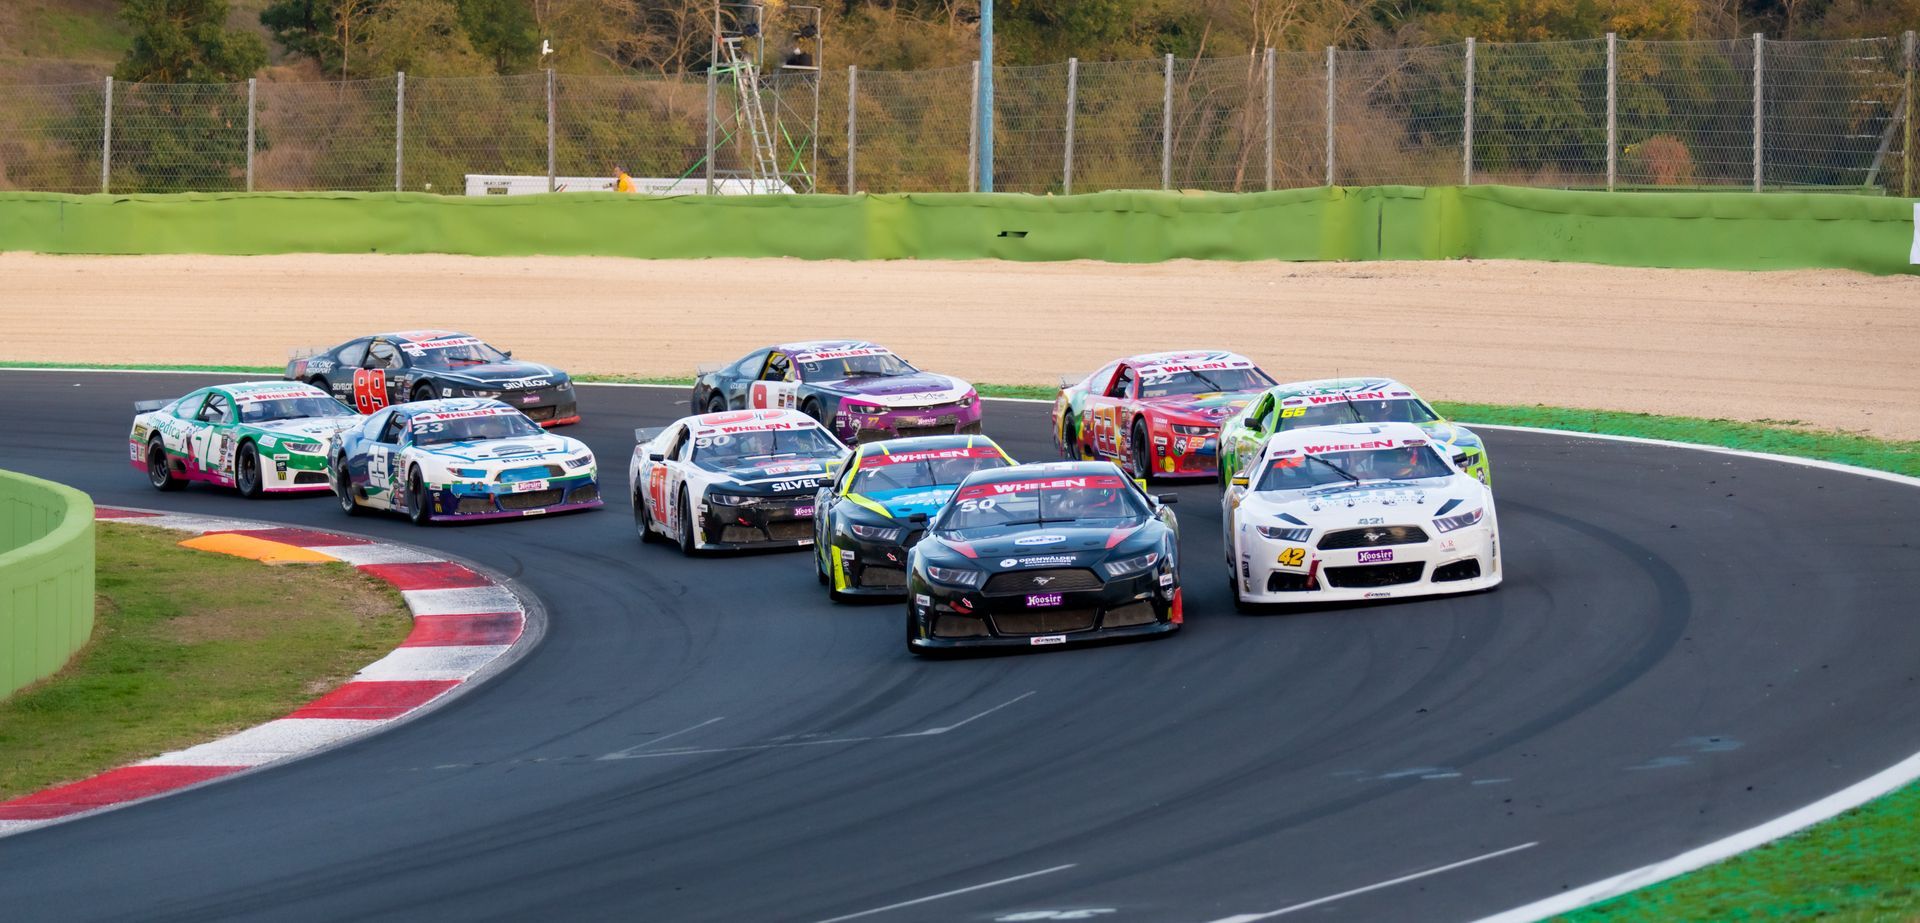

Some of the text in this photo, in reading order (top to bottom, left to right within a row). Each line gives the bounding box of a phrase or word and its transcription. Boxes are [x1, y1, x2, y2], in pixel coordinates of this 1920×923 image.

[418, 339, 464, 349] WHELEN
[808, 350, 872, 361] WHELEN
[1163, 363, 1227, 373] WHELEN
[503, 380, 551, 390] SILVELOX
[1143, 374, 1173, 386] 22
[254, 391, 307, 401] WHELEN
[354, 368, 389, 415] 89
[1309, 392, 1384, 404] WHELEN
[436, 408, 496, 420] WHELEN
[1281, 408, 1306, 418] 66
[414, 423, 443, 434] 23
[722, 423, 791, 433] WHELEN
[695, 435, 730, 448] 90
[1304, 440, 1393, 453] WHELEN
[889, 450, 969, 463] WHELEN
[993, 479, 1086, 494] WHELEN
[961, 499, 996, 512] 50
[1278, 548, 1306, 567] 42
[1360, 551, 1392, 561] Hoosier
[1026, 594, 1062, 605] Hoosier
